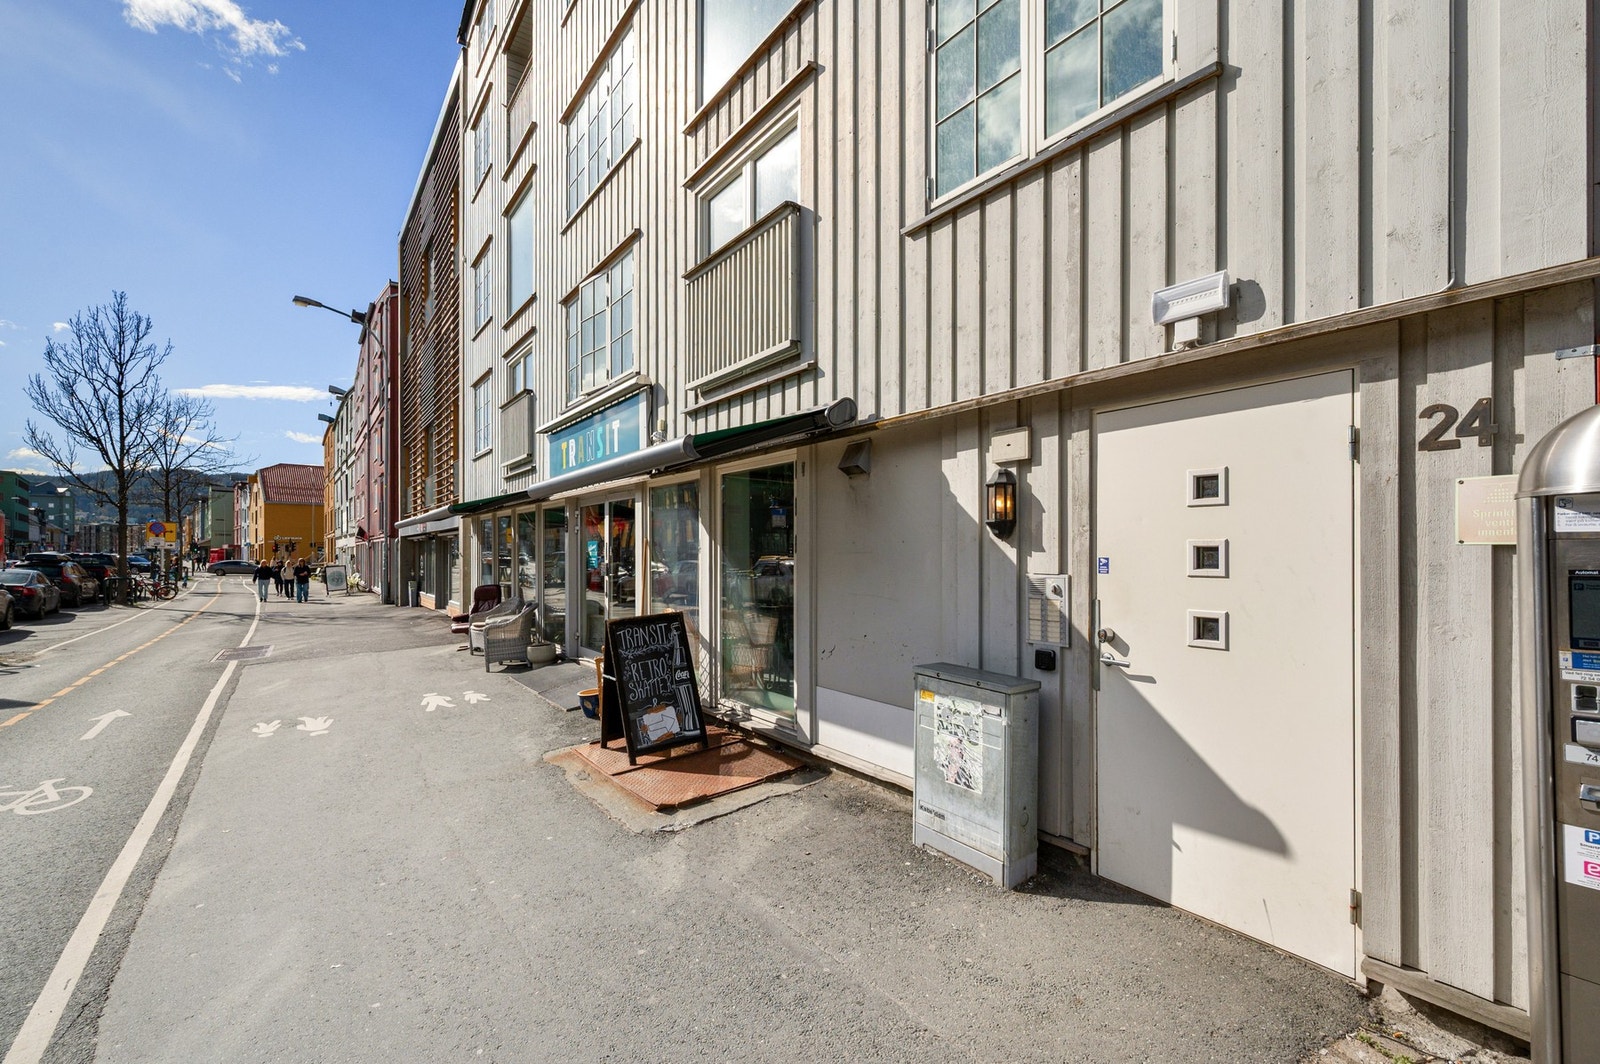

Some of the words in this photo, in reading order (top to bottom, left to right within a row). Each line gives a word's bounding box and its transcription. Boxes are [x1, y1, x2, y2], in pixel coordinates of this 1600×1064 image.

[1418, 397, 1499, 452] 24
[561, 419, 621, 470] TRANSIT
[617, 622, 669, 650] TRANSIT
[631, 658, 668, 682] RETRO
[628, 675, 673, 701] SKATTER
[1585, 753, 1599, 763] 74
